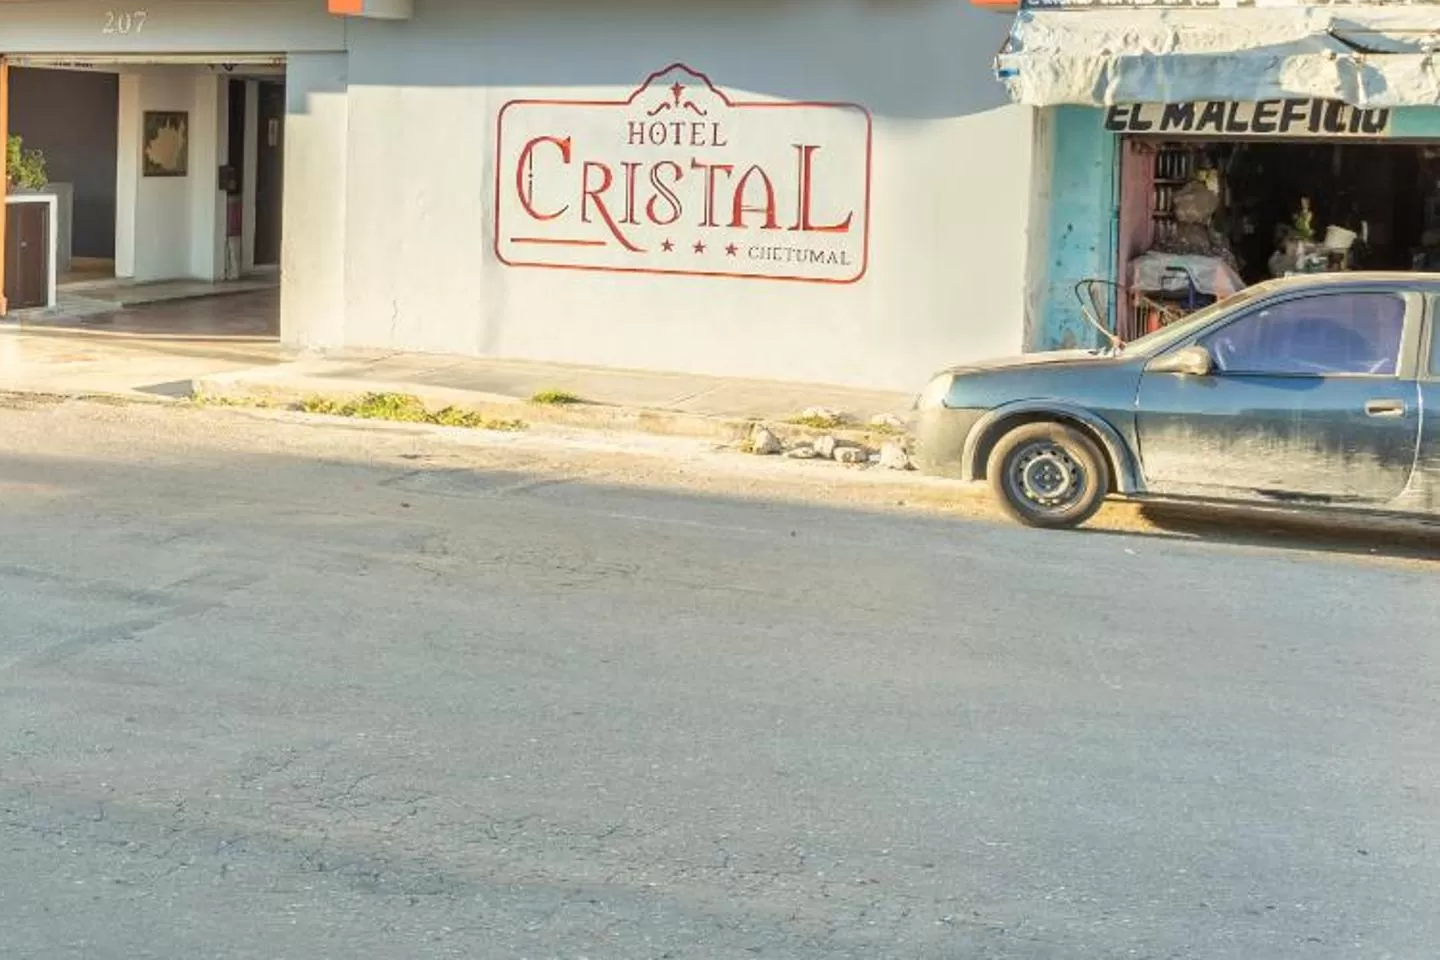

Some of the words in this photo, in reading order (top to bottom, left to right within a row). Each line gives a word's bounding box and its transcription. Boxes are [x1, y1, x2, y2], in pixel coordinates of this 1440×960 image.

[102, 10, 148, 34] 207
[1105, 104, 1152, 131] EL
[626, 121, 728, 147] HOTEL
[516, 135, 854, 252] CRISTAL
[747, 244, 852, 266] CHETUMAL
